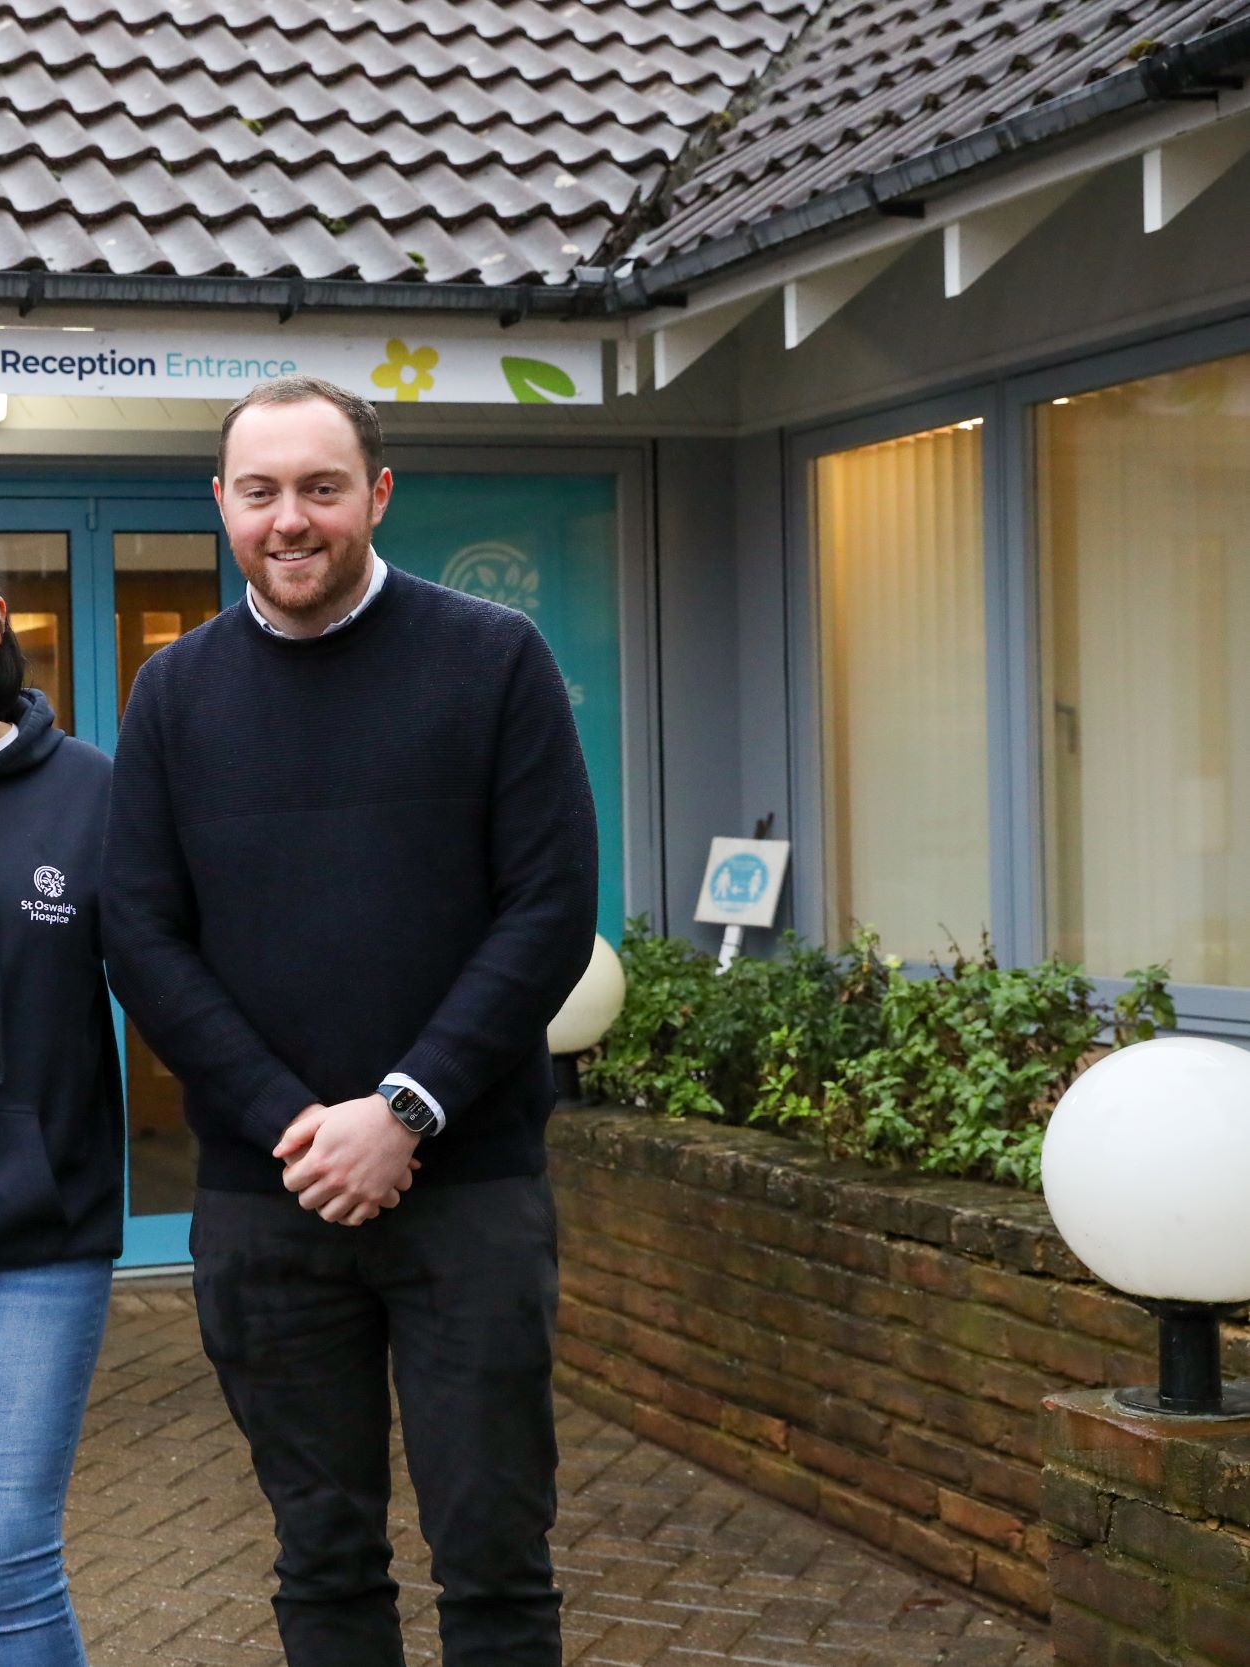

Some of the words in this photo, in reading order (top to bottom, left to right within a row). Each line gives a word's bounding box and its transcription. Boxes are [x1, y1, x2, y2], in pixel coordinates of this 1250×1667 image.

[0, 349, 156, 381] Reception
[166, 352, 297, 378] Entrance
[21, 900, 33, 910] St
[34, 900, 77, 915] Oswald's
[30, 910, 70, 925] Hospice
